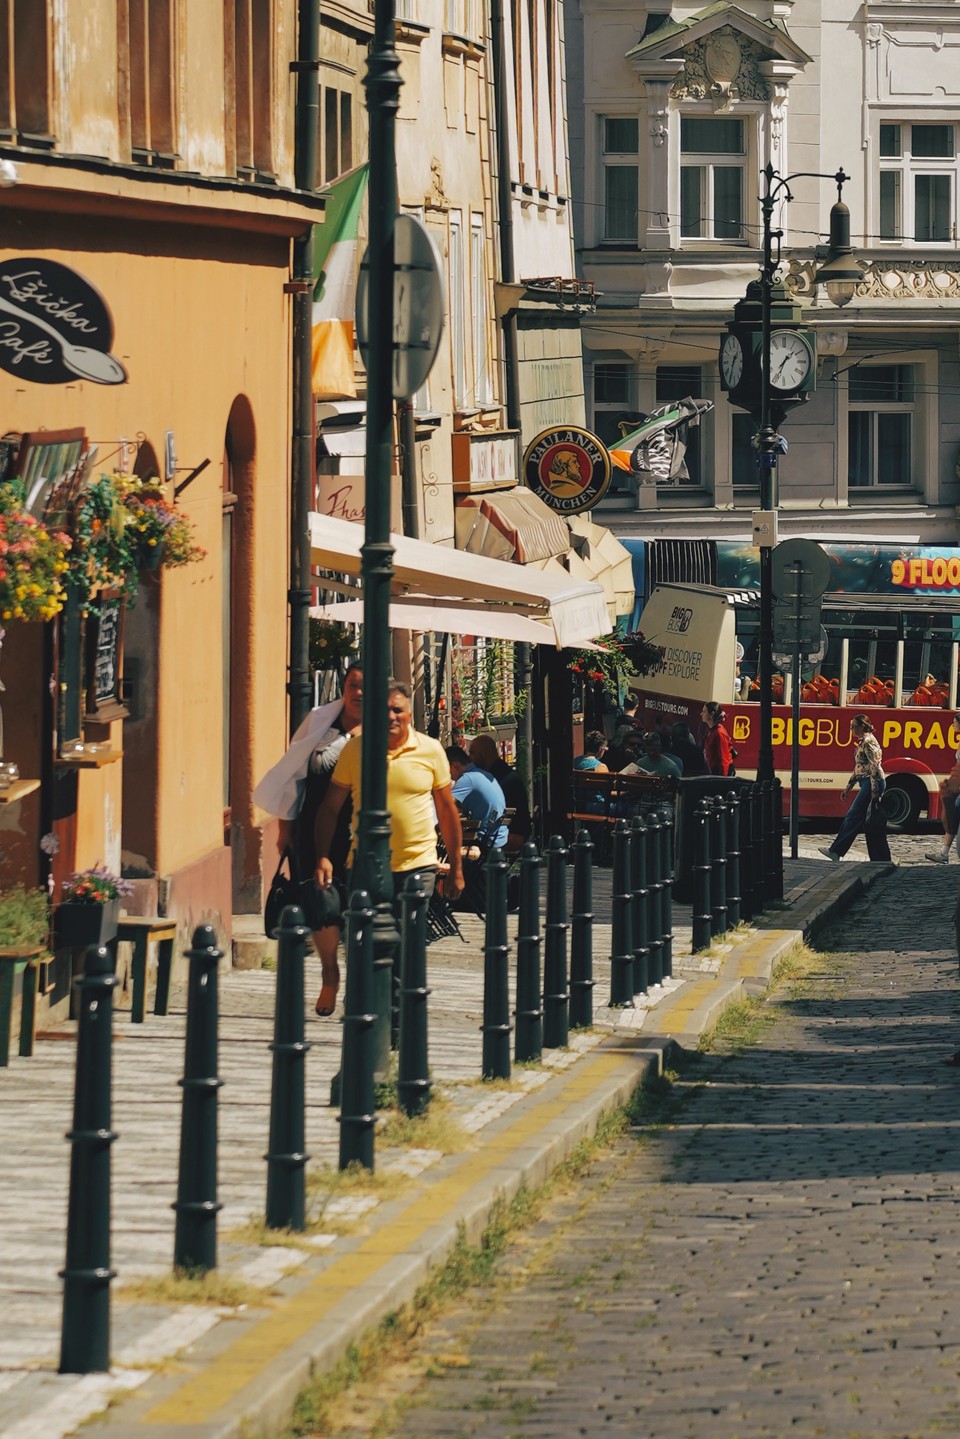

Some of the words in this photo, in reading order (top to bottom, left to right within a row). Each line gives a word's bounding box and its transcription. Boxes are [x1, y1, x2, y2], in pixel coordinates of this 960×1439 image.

[529, 431, 602, 465] PAULANER
[891, 558, 905, 585] 9
[667, 647, 703, 667] DISCOVER
[668, 662, 701, 681] EXPLORE
